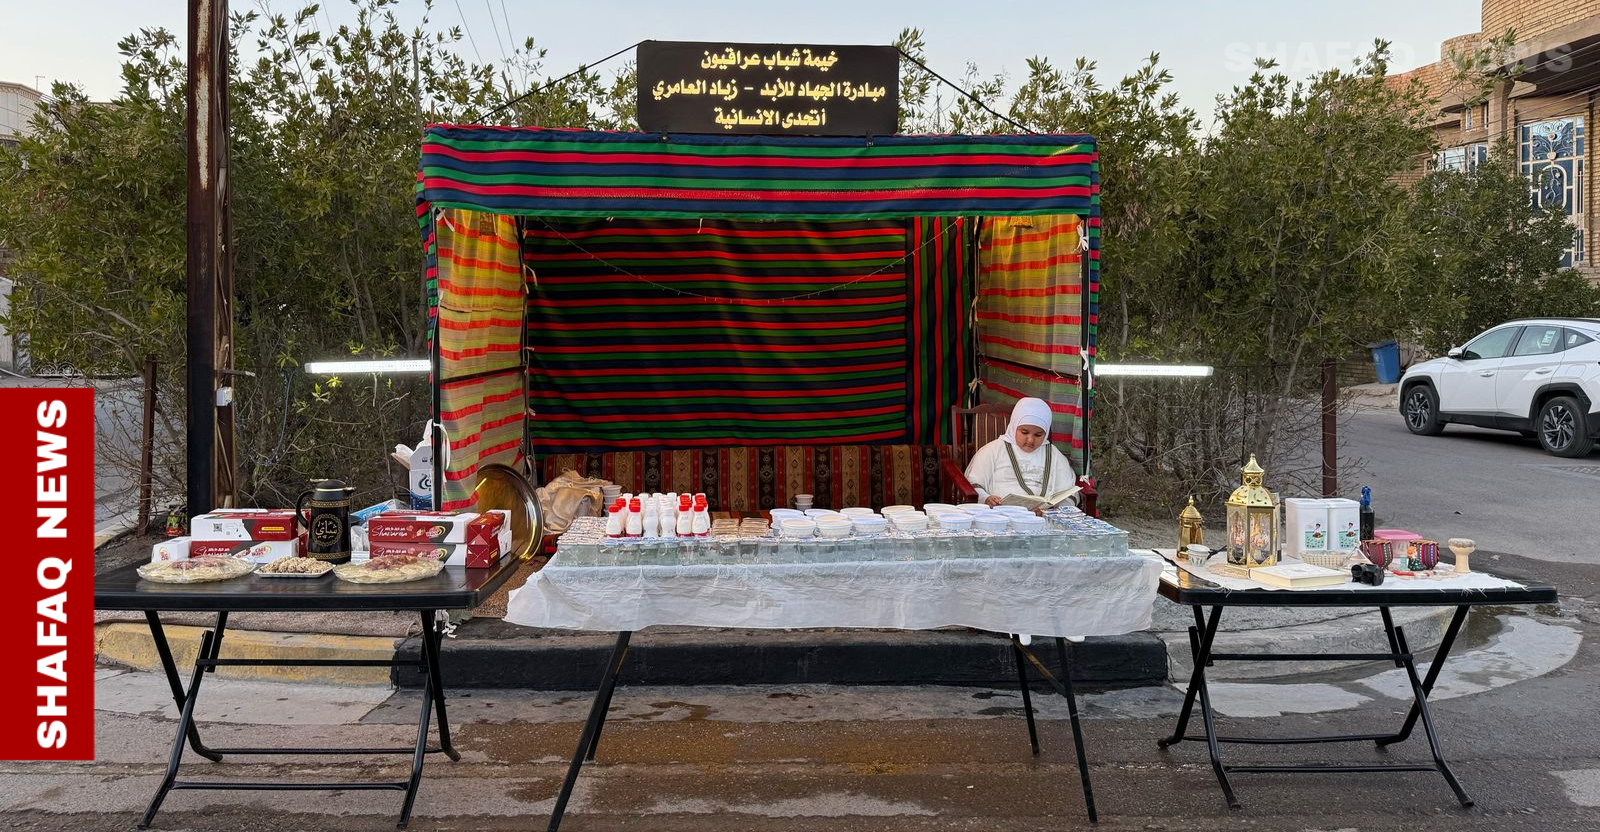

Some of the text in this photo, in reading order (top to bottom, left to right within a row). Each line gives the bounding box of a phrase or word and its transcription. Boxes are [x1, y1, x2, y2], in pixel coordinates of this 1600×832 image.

[701, 48, 838, 72] خيمة شباب عراقيون
[652, 79, 707, 101] العامري
[709, 79, 738, 101] زياد
[760, 78, 796, 102] للأبد
[798, 81, 842, 102] الجهاد
[843, 81, 886, 102] مبادرة
[714, 107, 780, 130] الانسانية
[315, 520, 338, 539] شاي
